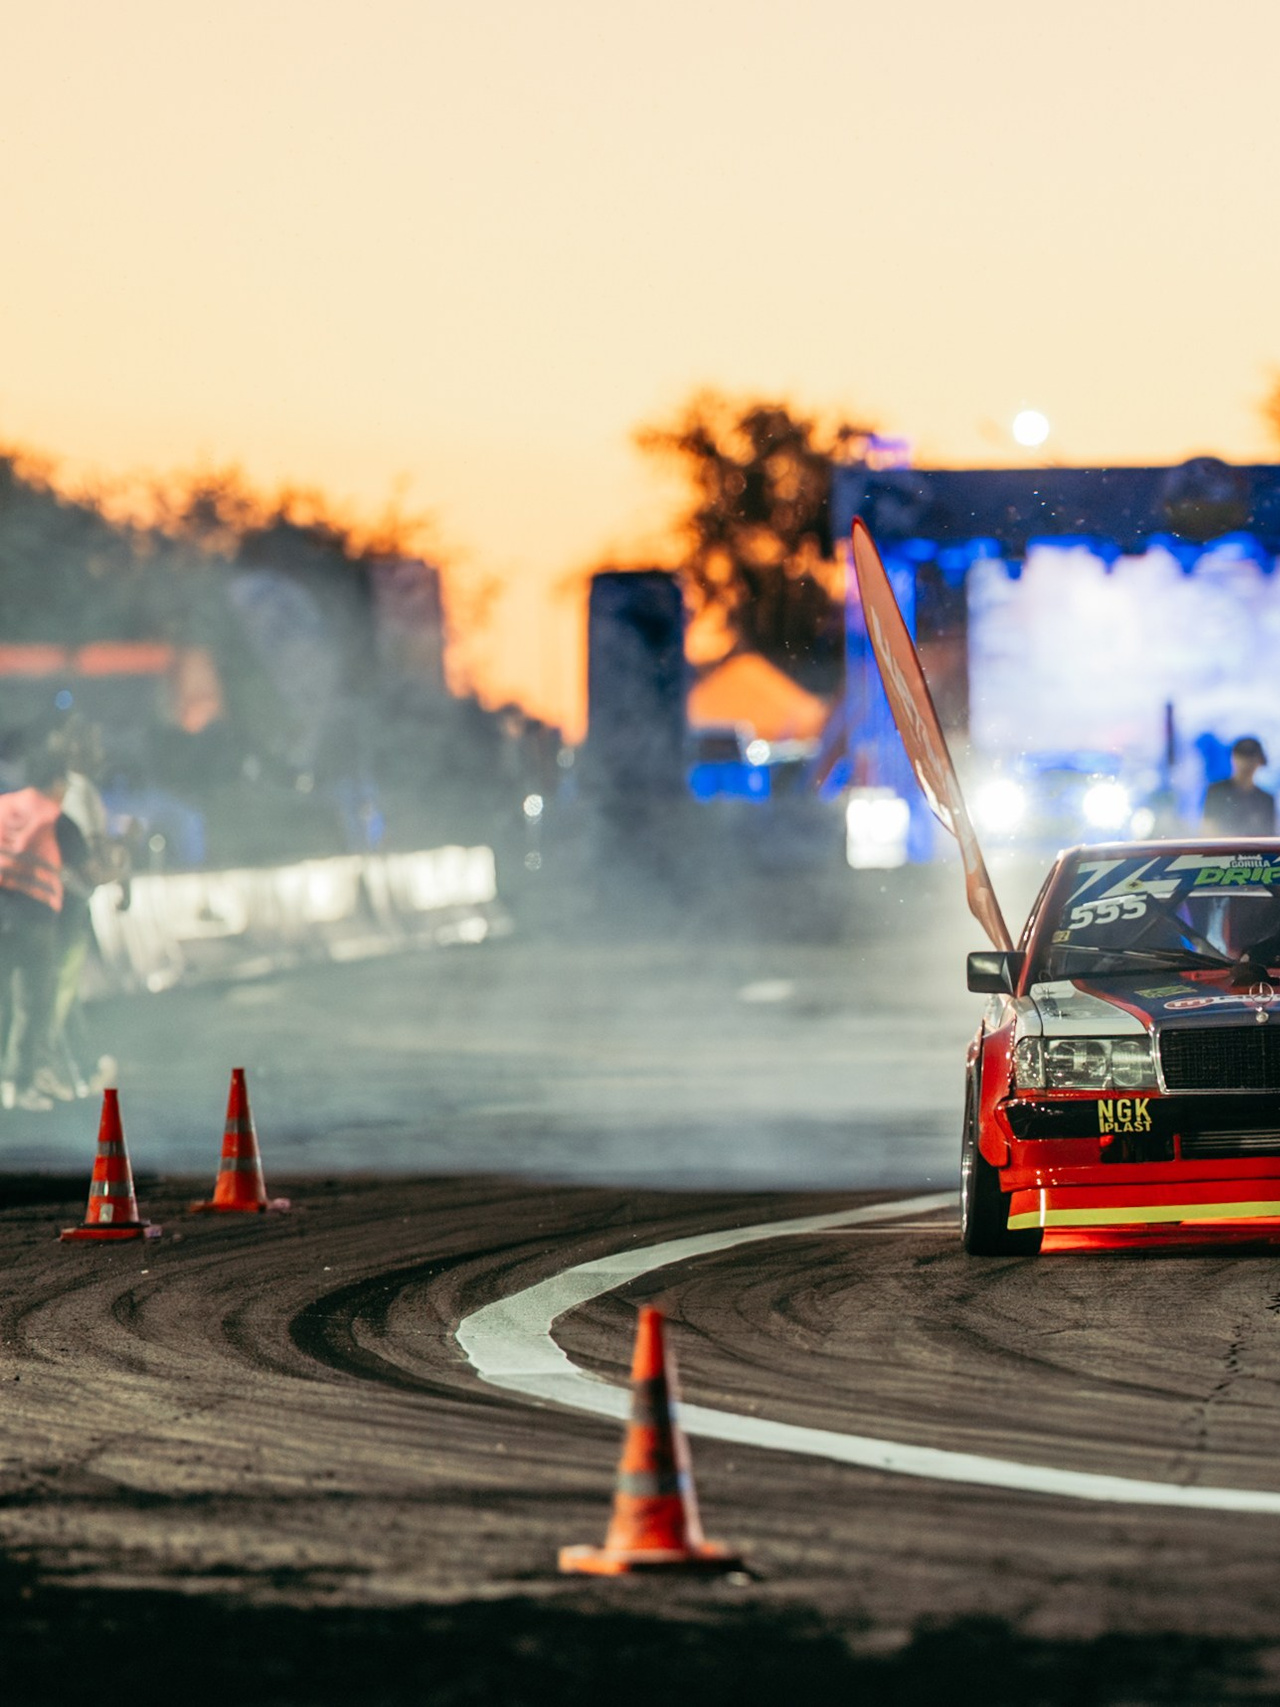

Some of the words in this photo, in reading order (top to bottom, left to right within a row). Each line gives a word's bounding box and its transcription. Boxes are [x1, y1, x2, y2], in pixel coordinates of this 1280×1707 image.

[1232, 859, 1271, 868] GORILLA
[1068, 894, 1147, 930] 555
[1098, 1098, 1151, 1132] NGK
[1105, 1121, 1152, 1133] PLAST
